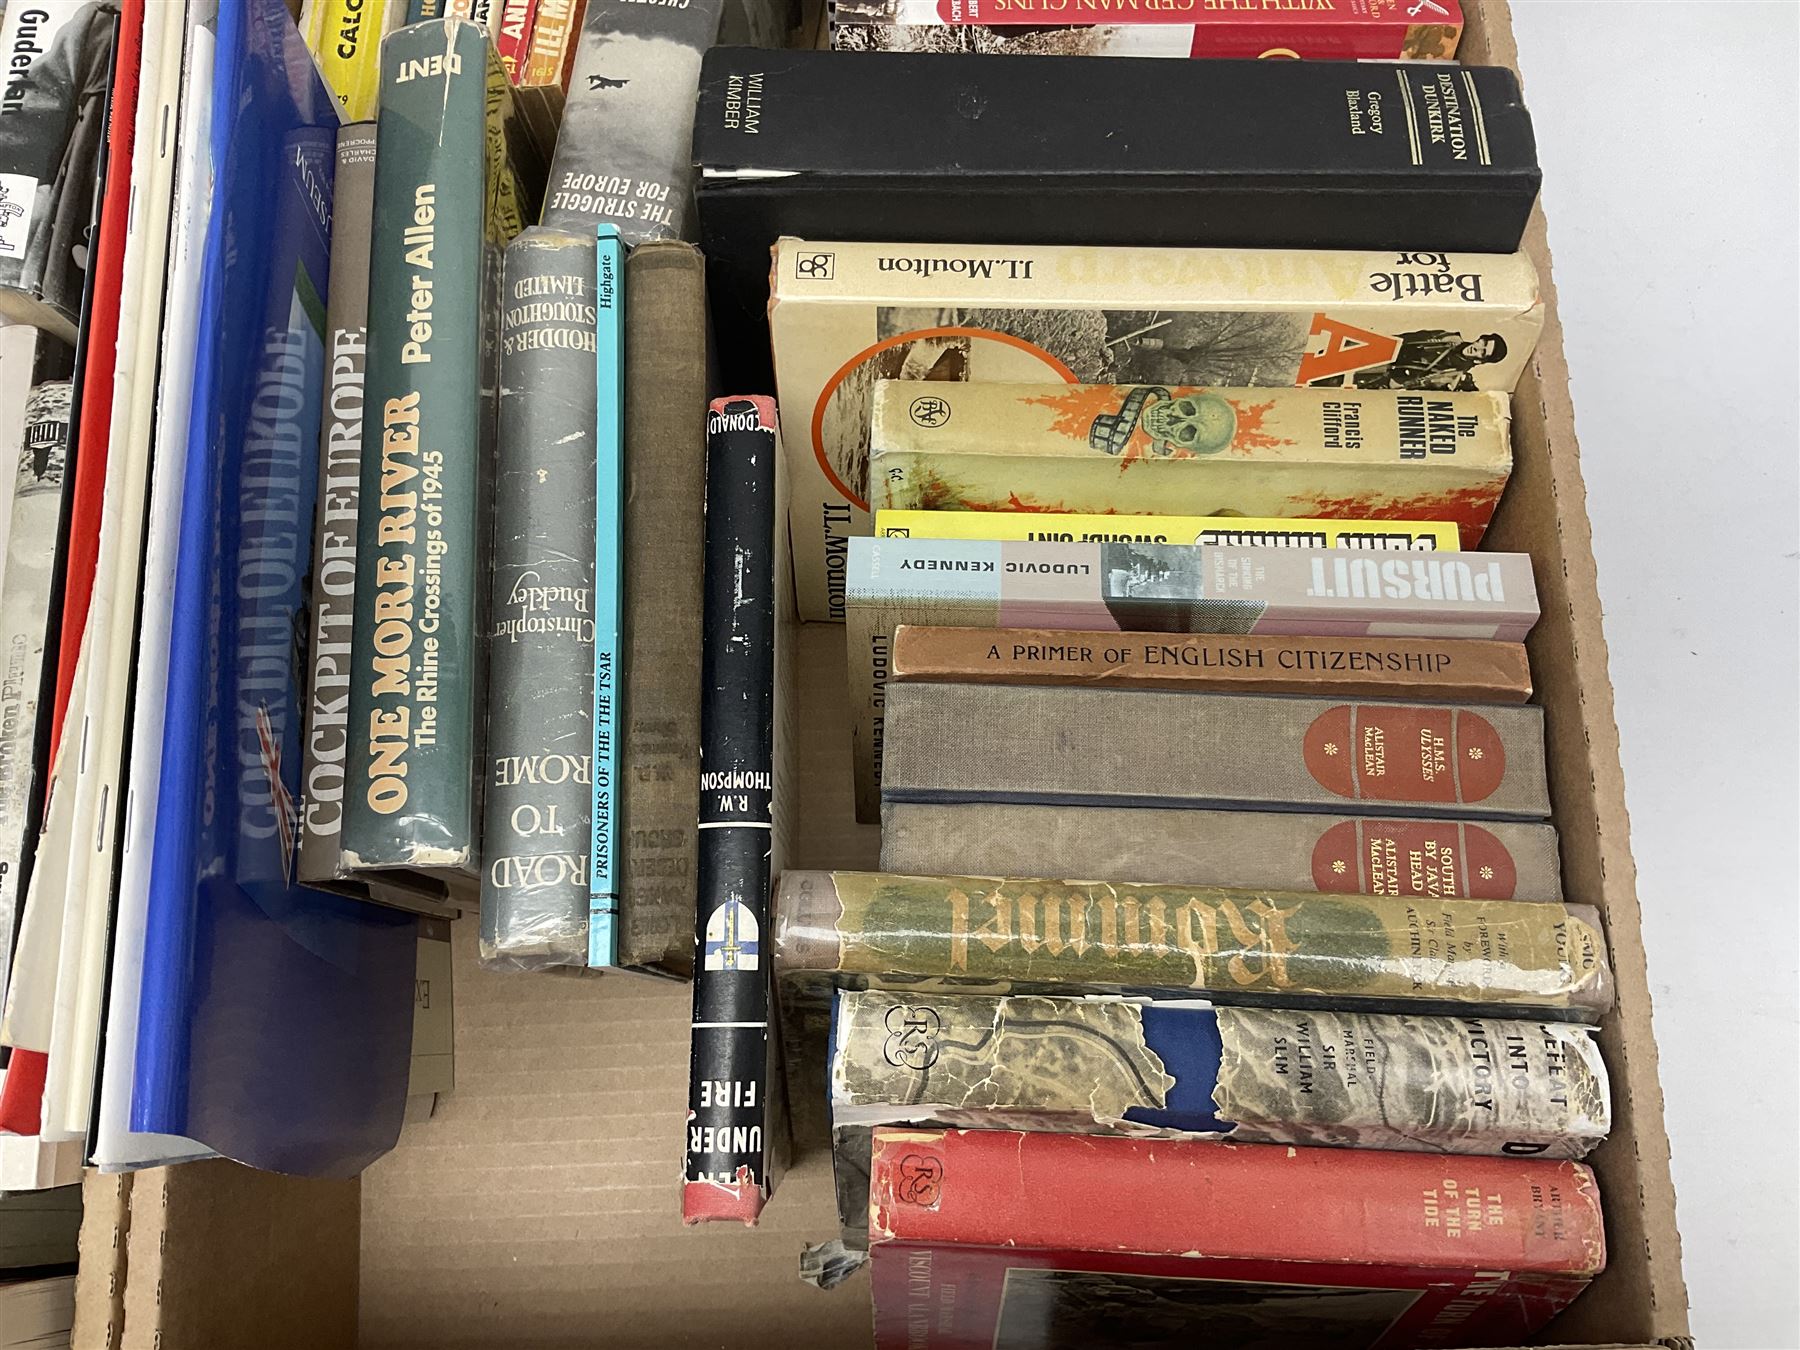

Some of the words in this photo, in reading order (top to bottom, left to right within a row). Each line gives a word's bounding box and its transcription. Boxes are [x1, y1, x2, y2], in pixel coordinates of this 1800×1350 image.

[533, 25, 565, 58] ILL
[396, 53, 462, 84] DENT
[724, 75, 743, 130] KIMBER
[744, 72, 764, 135] WILLIAM
[1345, 89, 1366, 136] Blaxland
[1366, 91, 1383, 135] Gregory
[1421, 84, 1446, 145] DUNKIRK
[1436, 72, 1467, 161] DESTINATION
[561, 172, 632, 196] EUROPE
[636, 181, 670, 202] FOR
[550, 191, 638, 218] STRUGGLE
[640, 206, 673, 227] THE
[403, 183, 437, 269] Allen
[1396, 252, 1451, 271] for
[514, 275, 585, 299] LIMITED
[599, 253, 613, 310] Highgate
[1370, 271, 1484, 302] Battle
[402, 276, 433, 365] Peter
[504, 301, 596, 330] STOUGHTON
[503, 335, 514, 357] &
[516, 328, 596, 353] HODDER
[323, 327, 367, 526] EUROPE
[1322, 402, 1343, 449] Clifford
[1343, 402, 1362, 449] Francis
[1396, 395, 1426, 460] RUNNER
[1427, 400, 1456, 455] NAKED
[1456, 415, 1479, 438] The
[378, 391, 421, 548] RIVER
[421, 450, 444, 498] 1945
[418, 498, 443, 526] of
[319, 532, 358, 597] OF
[418, 531, 448, 633] Crossings
[899, 559, 995, 573] KENNEDY
[1005, 561, 1090, 575] LUDOVIC
[1306, 557, 1506, 602] PURSUIT
[507, 570, 589, 613] Buckley
[372, 553, 416, 698] MORE
[494, 606, 596, 643] Christopher
[416, 636, 439, 704] Rhine
[599, 651, 612, 691] TSAR
[986, 645, 1001, 660] A
[1012, 646, 1094, 663] PRIMER
[1103, 648, 1132, 664] OF
[1144, 646, 1264, 669] ENGLISH
[1278, 649, 1452, 674] CITIZENSHIP
[306, 603, 354, 838] COCKPIT
[414, 707, 437, 749] The
[599, 692, 612, 725] THE
[366, 704, 411, 815] ONE
[598, 726, 611, 762] THE
[1373, 726, 1386, 777] ALISTAIR
[1420, 728, 1435, 783] ULYSSES
[1432, 736, 1446, 775] H.M.S.
[495, 755, 591, 787] ROME
[598, 766, 610, 787] OF
[701, 770, 772, 792] THOMPSON
[511, 804, 559, 835] TO
[596, 789, 610, 880] PRISONERS
[1385, 838, 1400, 896] ALISTAIR
[1424, 840, 1437, 860] BY
[491, 855, 588, 888] ROAD
[1409, 849, 1424, 892] HEAD
[1440, 846, 1456, 896] SOUTH
[1442, 912, 1456, 938] Field
[1497, 932, 1509, 957] With
[1463, 940, 1474, 954] by
[1274, 1037, 1289, 1075] SLIM
[1297, 1022, 1314, 1094] WILLIAM
[1322, 1044, 1335, 1071] SIR
[1506, 1036, 1530, 1090] INTO
[701, 1079, 756, 1108] FIRE
[690, 1125, 762, 1154] UNDER
[1422, 1189, 1440, 1228] TIDE
[1443, 1179, 1458, 1201] OF
[1465, 1187, 1482, 1232] TURN
[1486, 1193, 1503, 1226] THE
[1445, 1204, 1461, 1239] THE
